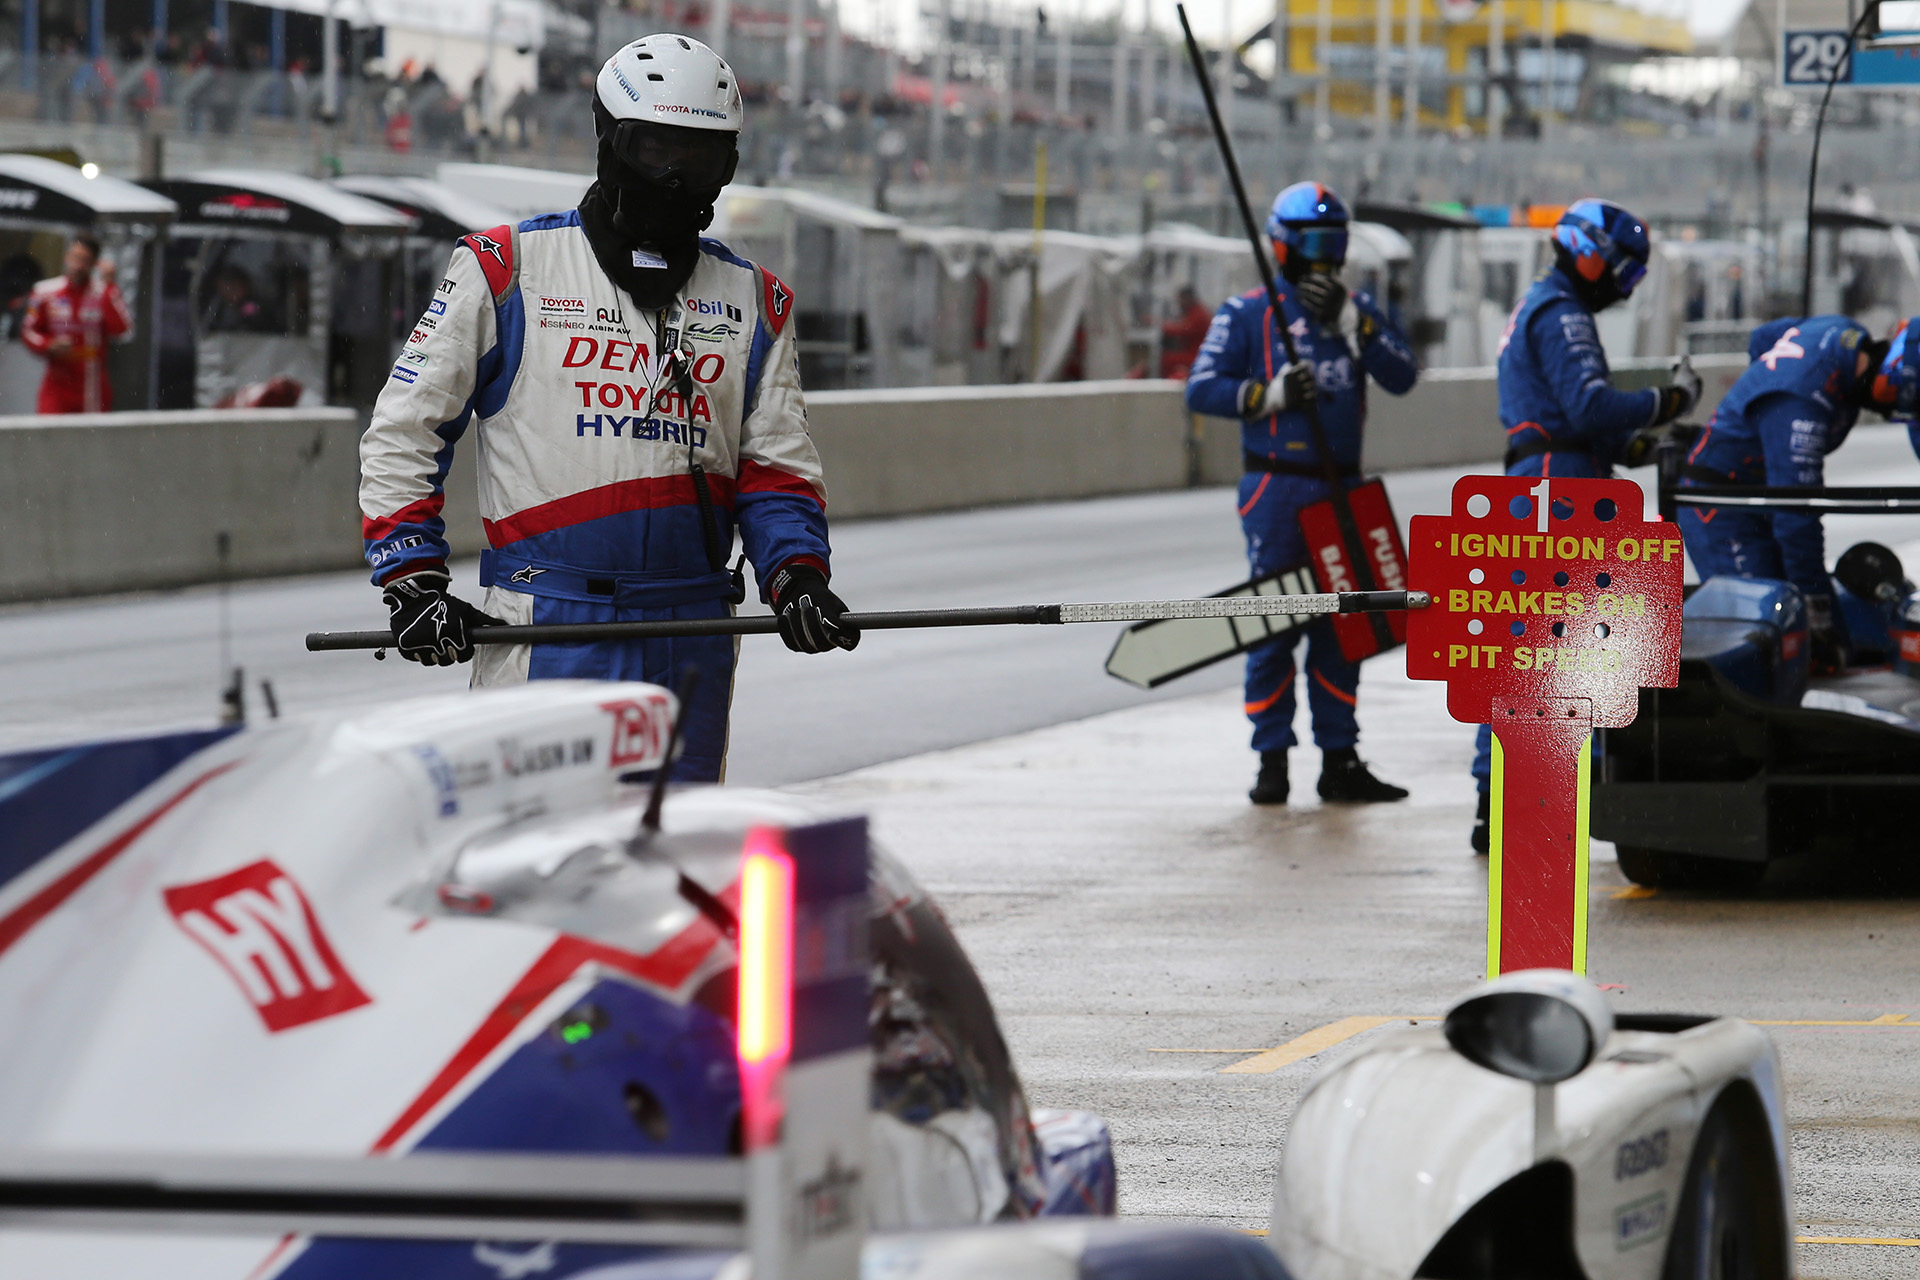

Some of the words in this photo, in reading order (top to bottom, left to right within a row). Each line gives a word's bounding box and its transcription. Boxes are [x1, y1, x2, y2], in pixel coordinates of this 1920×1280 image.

[1789, 34, 1849, 80] 29
[653, 104, 690, 114] TOYOTA
[691, 107, 727, 120] HYBRID
[541, 297, 585, 308] TOYOTA
[684, 298, 722, 316] obil
[540, 317, 585, 330] NISSHINBO
[562, 336, 725, 384] DENO
[575, 381, 712, 423] TOYOTA
[576, 414, 708, 449] HYBRID
[1530, 479, 1550, 533] 1
[1450, 533, 1604, 561] IGNITION
[1616, 538, 1682, 562] OFF
[1319, 544, 1353, 617] BAC
[1448, 589, 1585, 616] BRAKES
[1596, 593, 1646, 618] ON
[1448, 644, 1503, 669] PIT
[1512, 646, 1623, 673] SPEED
